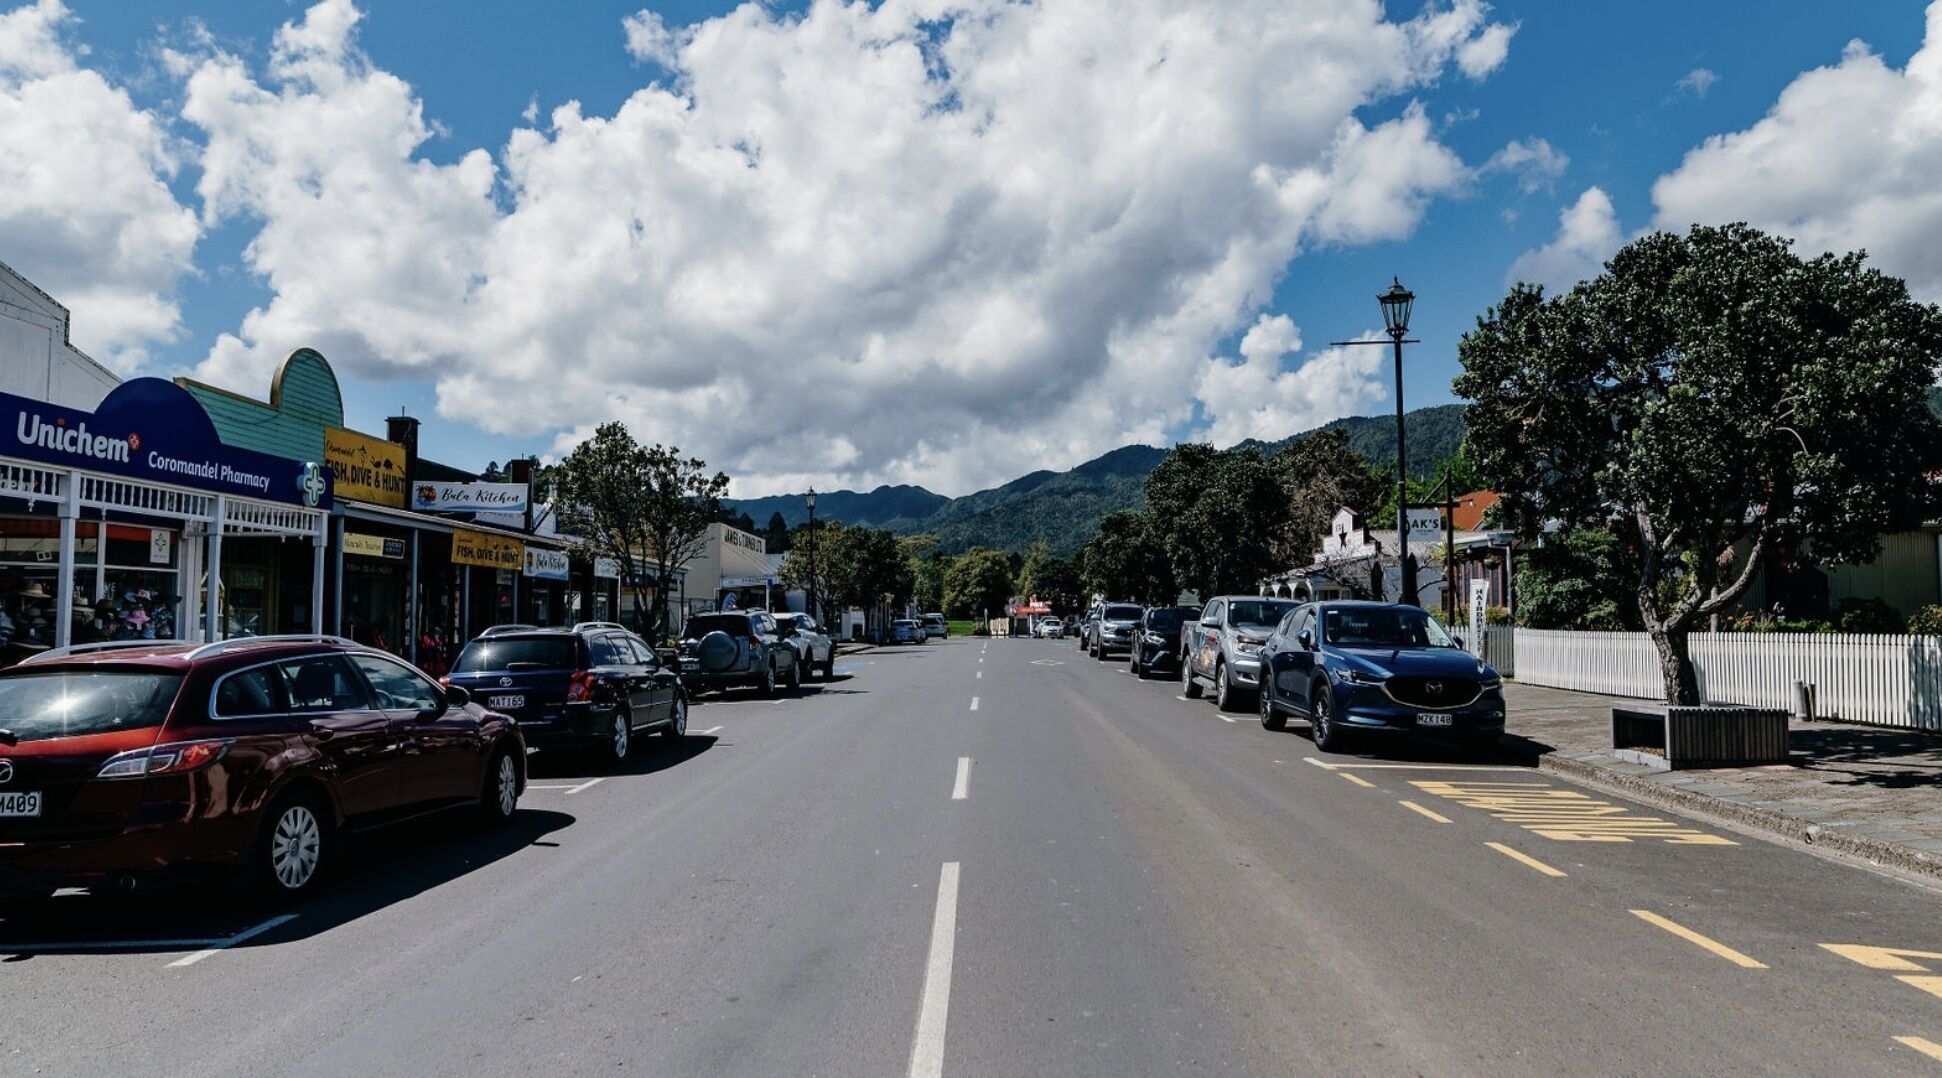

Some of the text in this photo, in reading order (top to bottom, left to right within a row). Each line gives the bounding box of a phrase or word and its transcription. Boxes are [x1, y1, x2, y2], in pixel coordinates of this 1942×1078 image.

[17, 411, 130, 463] Unichem
[148, 450, 270, 493] Coromandel Pharmacy
[351, 464, 372, 487] DIVE
[374, 470, 381, 488] &
[382, 473, 405, 494] HUNT
[475, 488, 520, 504] Kitchen
[477, 547, 492, 561] DIVE
